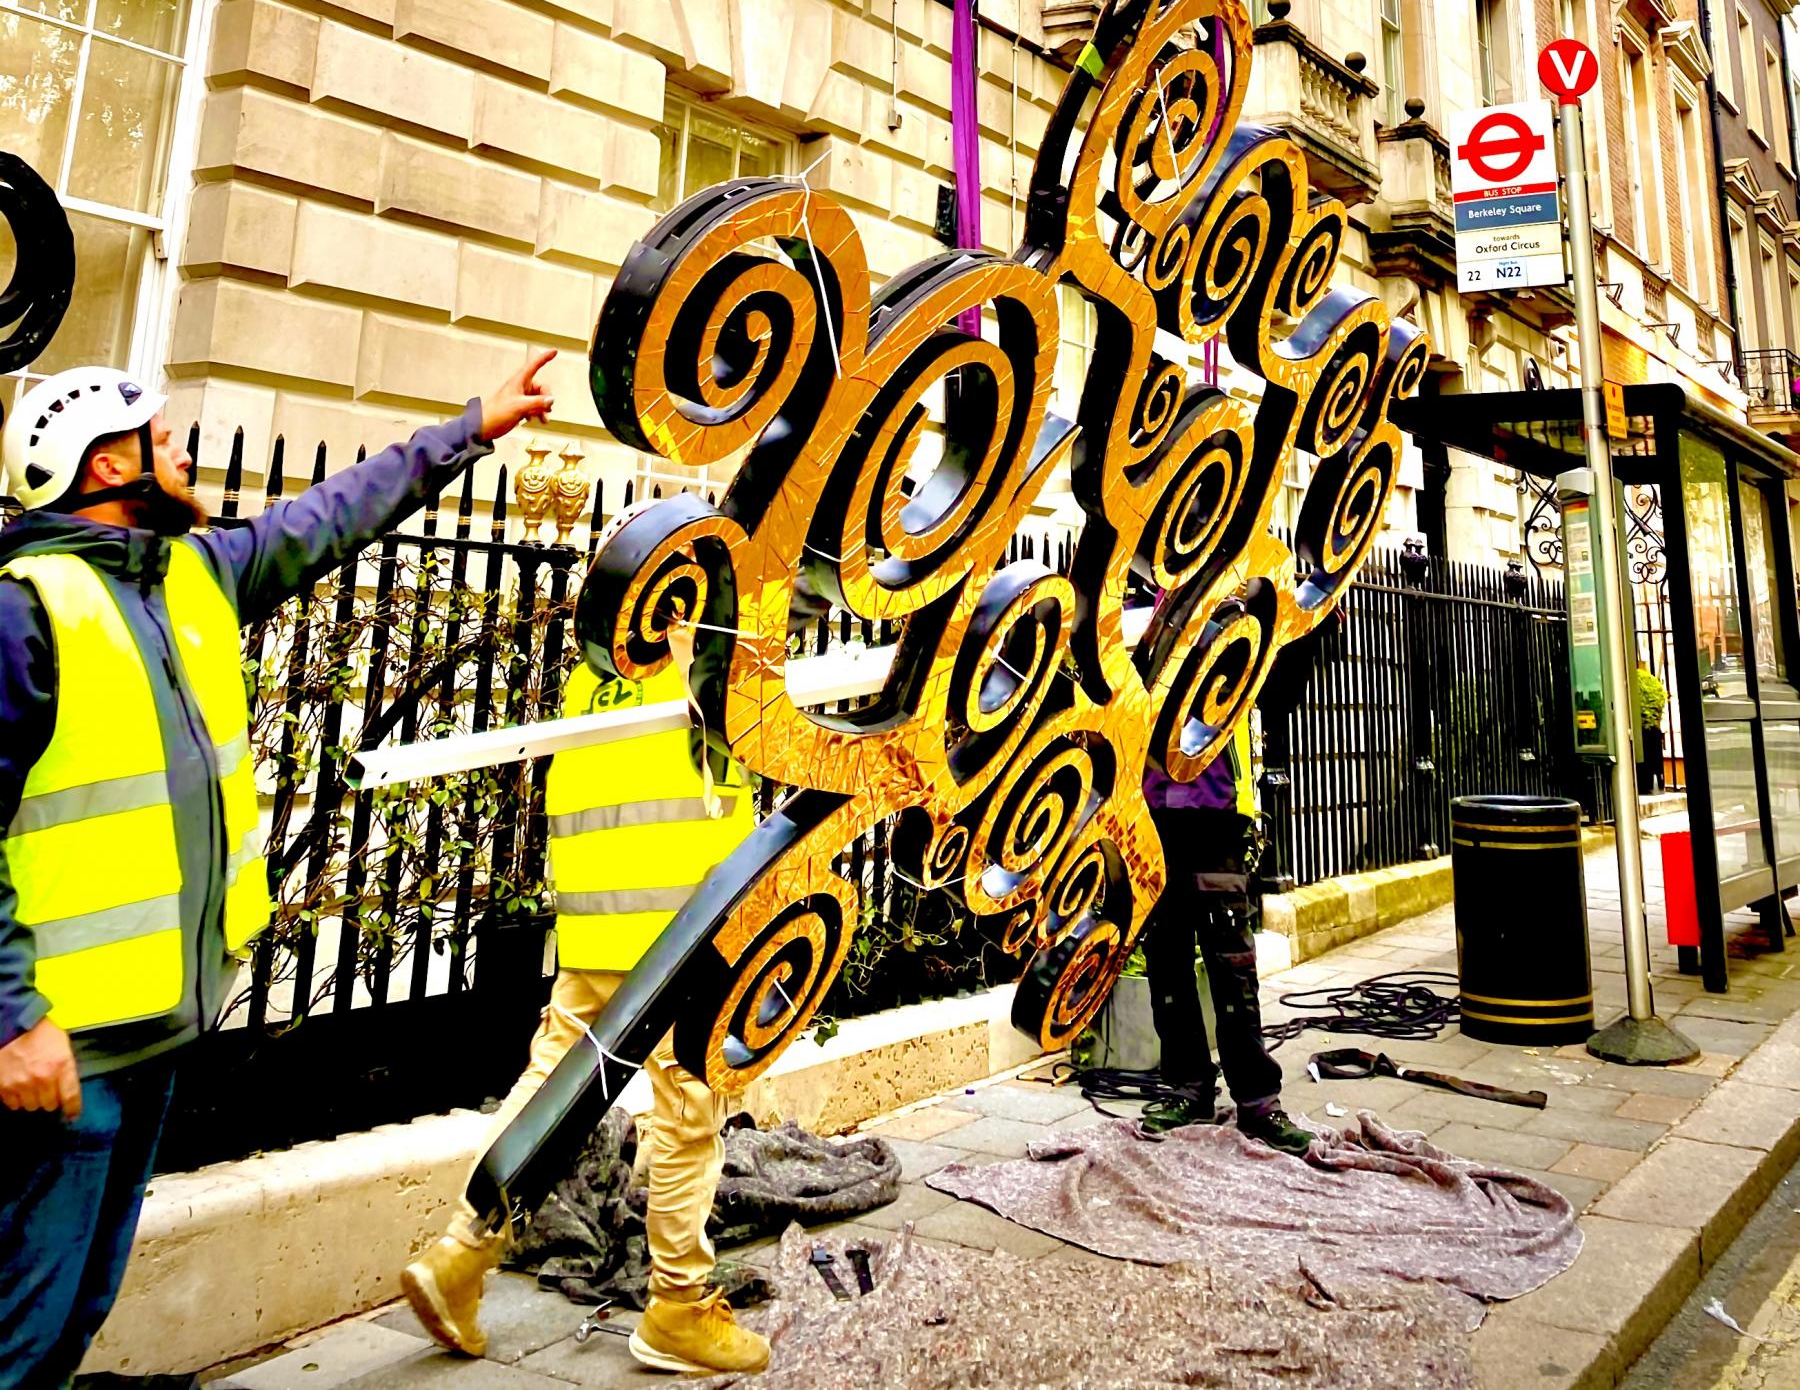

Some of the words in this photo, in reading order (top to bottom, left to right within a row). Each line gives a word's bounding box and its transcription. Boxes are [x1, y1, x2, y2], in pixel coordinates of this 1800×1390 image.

[1548, 50, 1587, 89] V
[1483, 190, 1499, 198] BUS
[1501, 186, 1522, 196] STOP
[1468, 207, 1507, 219] Berkeley
[1509, 203, 1542, 216] Square
[1493, 234, 1520, 242] towards
[1475, 243, 1508, 254] Oxford
[1510, 241, 1541, 251] Circus
[1467, 270, 1482, 282] 22
[1496, 266, 1522, 279] N22
